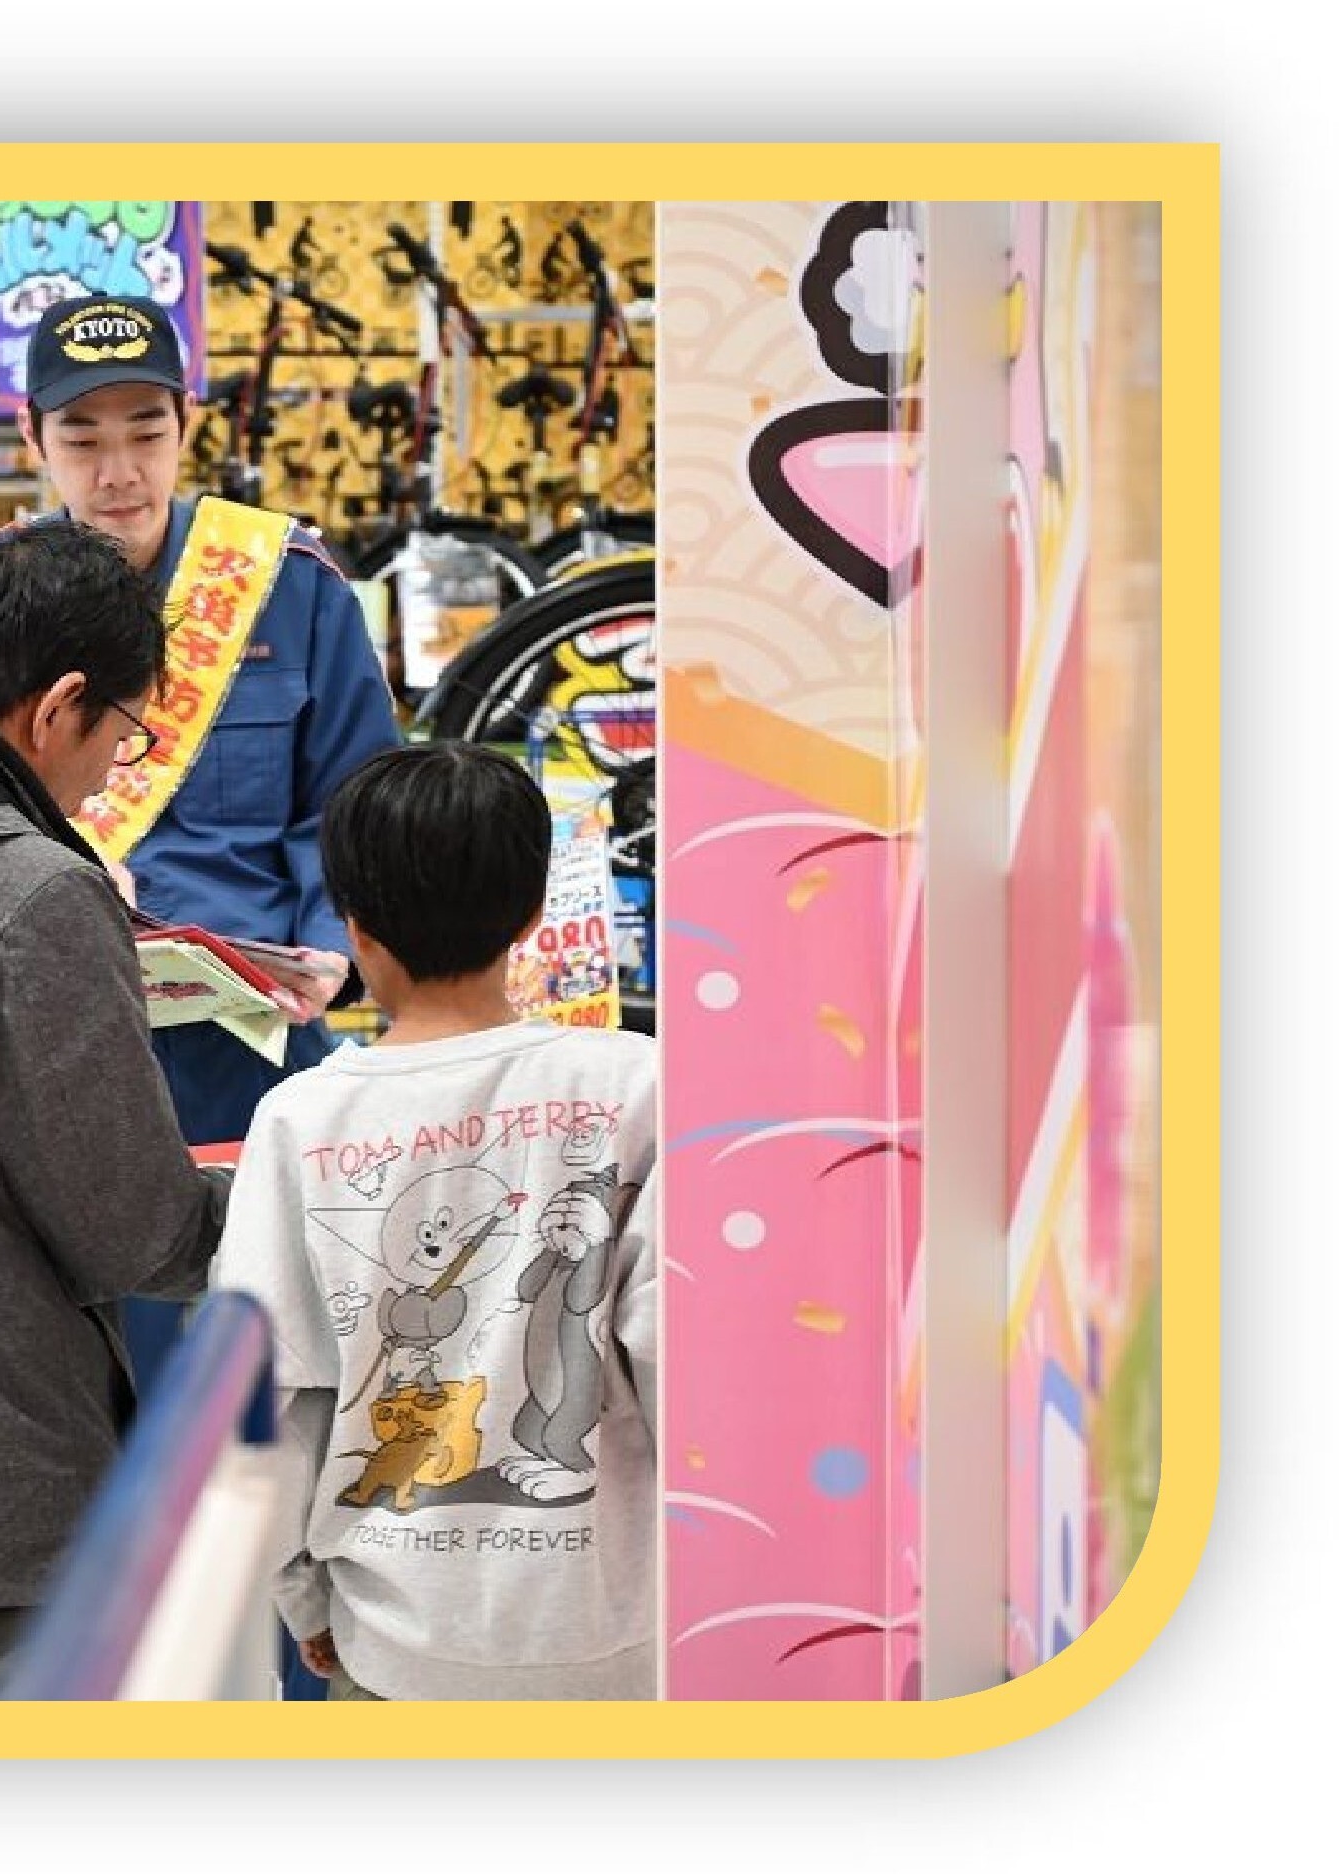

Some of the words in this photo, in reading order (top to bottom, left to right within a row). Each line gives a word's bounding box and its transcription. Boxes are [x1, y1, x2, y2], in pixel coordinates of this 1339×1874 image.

[74, 318, 138, 342] KYOTO
[302, 1136, 403, 1182] TOM
[411, 1121, 486, 1161] AND
[492, 1100, 624, 1148] JERRY
[352, 1526, 465, 1553] TOGETHER
[476, 1526, 595, 1552] FOREVER
